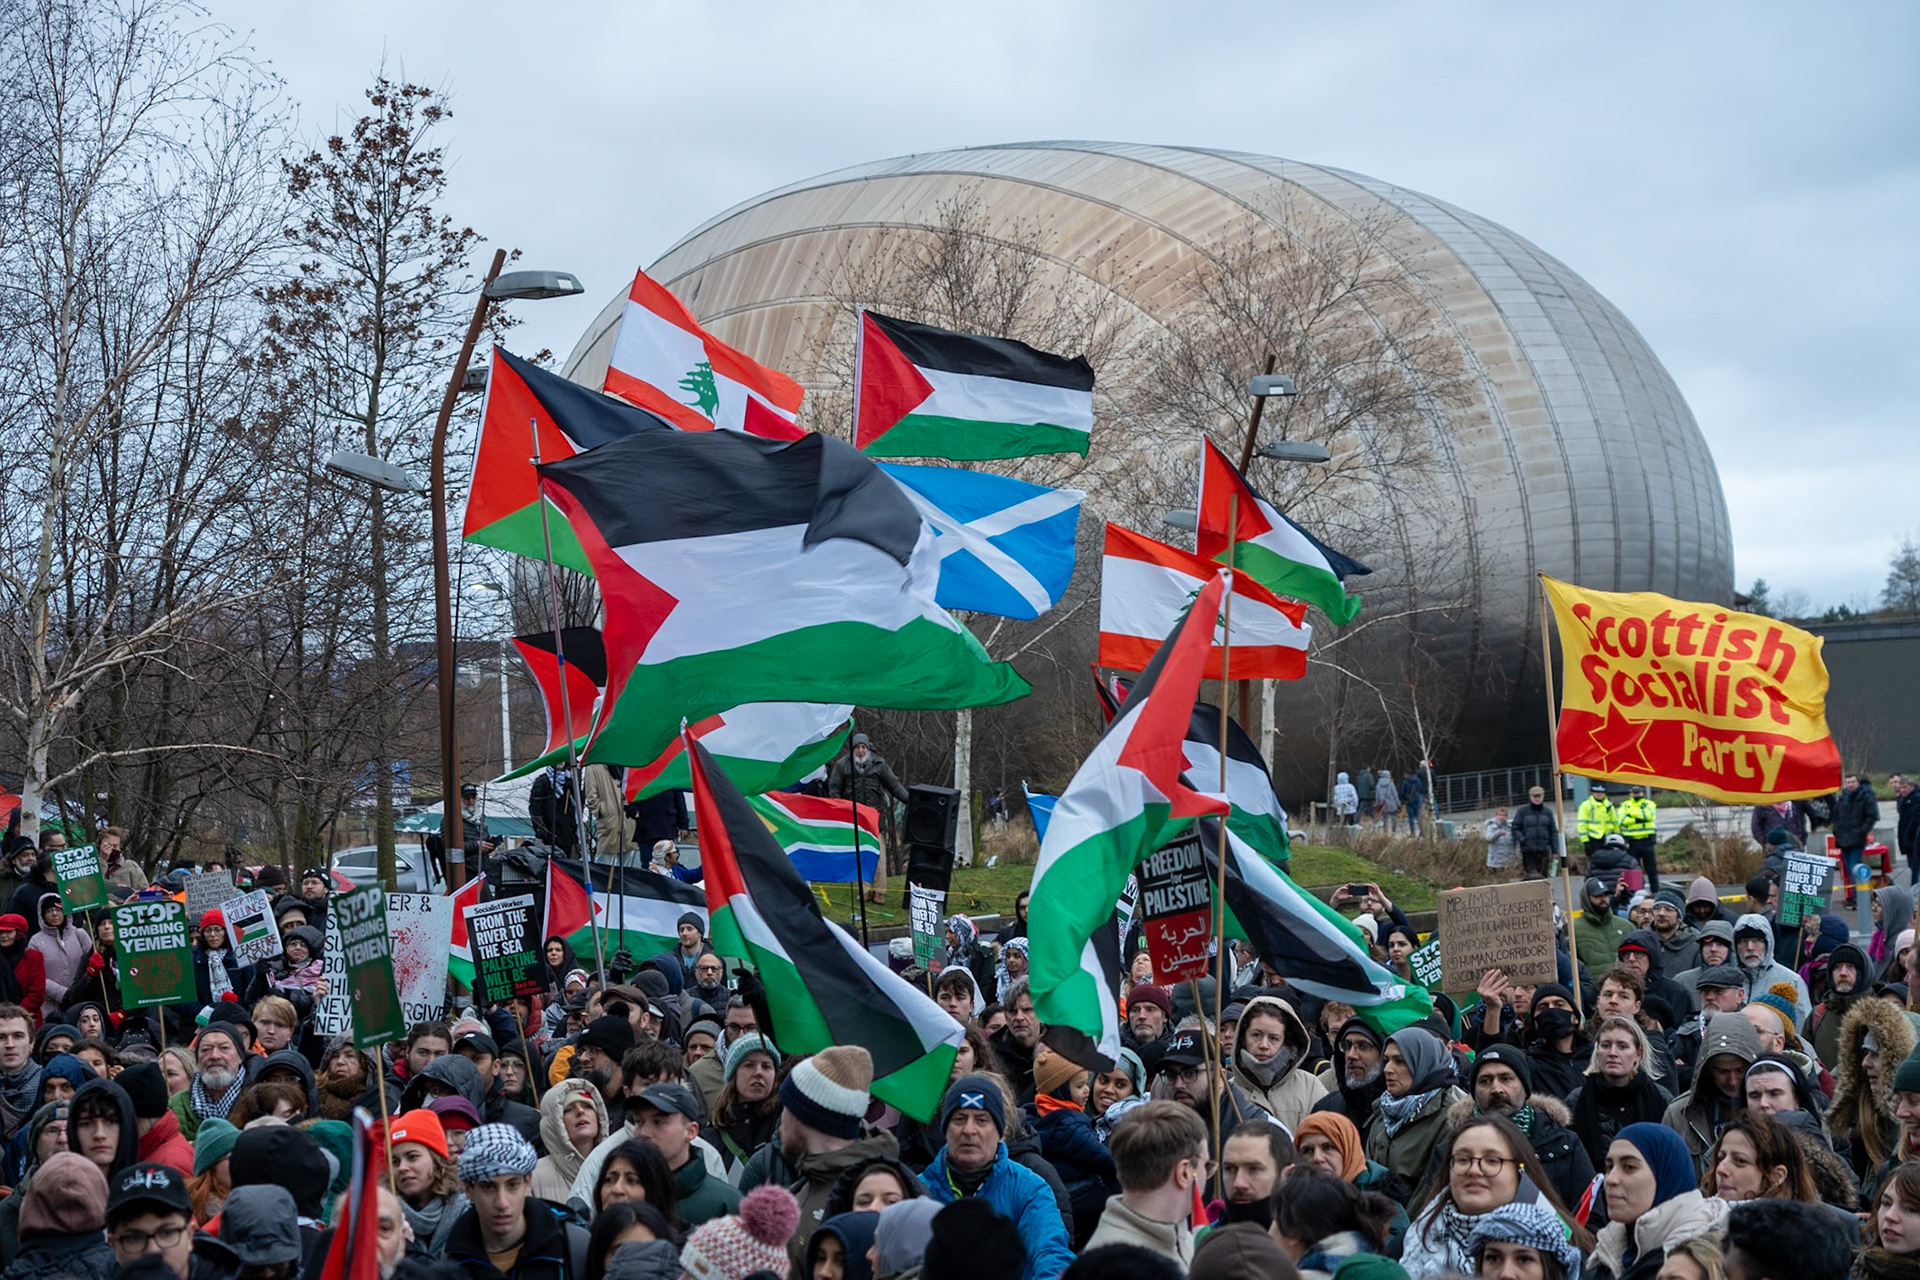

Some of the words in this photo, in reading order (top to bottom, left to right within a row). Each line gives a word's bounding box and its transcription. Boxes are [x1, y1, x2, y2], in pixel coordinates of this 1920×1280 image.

[1572, 603, 1796, 684] Scottish
[1580, 654, 1790, 725] Socialist
[1683, 722, 1786, 792] Party
[54, 845, 94, 864] STOP
[56, 857, 97, 872] BOMBING
[1142, 842, 1201, 879] FREEDOM
[58, 864, 99, 881] YEMEN
[1786, 870, 1810, 884] RIVER
[1811, 874, 1823, 886] TO
[1787, 859, 1811, 873] FROM
[1812, 864, 1828, 876] THE
[1170, 872, 1183, 885] for
[1784, 881, 1800, 893] THE
[1801, 884, 1818, 896] SEA
[225, 897, 244, 910] STOP
[245, 892, 260, 903] THE
[337, 888, 381, 926] STOP
[474, 904, 500, 914] Socialist
[500, 900, 523, 909] Worker
[1143, 878, 1210, 917] PALESTINE
[1783, 892, 1826, 908] PALESTINE
[116, 902, 181, 926] STOP
[227, 899, 267, 922] KILLINGS
[473, 912, 505, 932] FROM
[505, 908, 528, 925] THE
[1456, 906, 1496, 923] DEMAND
[1497, 899, 1545, 916] CEASEFIRE
[1781, 913, 1800, 925] FREE
[1782, 902, 1801, 914] WILL
[1803, 905, 1815, 917] BE
[118, 921, 185, 938] BOMBING
[342, 916, 384, 945] BOMBING
[475, 927, 508, 946] RIVER
[508, 924, 525, 939] TO
[1456, 922, 1479, 938] SHUT
[1481, 919, 1510, 934] DOWN
[1511, 915, 1542, 930] ELBIT
[120, 934, 186, 953] YEMEN
[234, 934, 278, 959] CEASEFIRE
[345, 935, 388, 968] YEMEN
[478, 943, 500, 960] THE
[501, 938, 523, 956] SEA
[1458, 936, 1491, 953] IMPOSE
[1495, 930, 1548, 948] SANCTIONS
[247, 945, 274, 964] NOW
[481, 950, 538, 974] PALESTINE
[1410, 940, 1440, 968] STO
[483, 970, 510, 987] WILL
[511, 967, 527, 981] BE
[1415, 956, 1441, 977] BOMB
[1460, 966, 1501, 982] COND
[1419, 968, 1442, 987] YEM
[487, 984, 513, 1001] FREE
[317, 998, 352, 1016] NEV
[403, 1002, 444, 1021] RGIV
[315, 1016, 353, 1034] NEV
